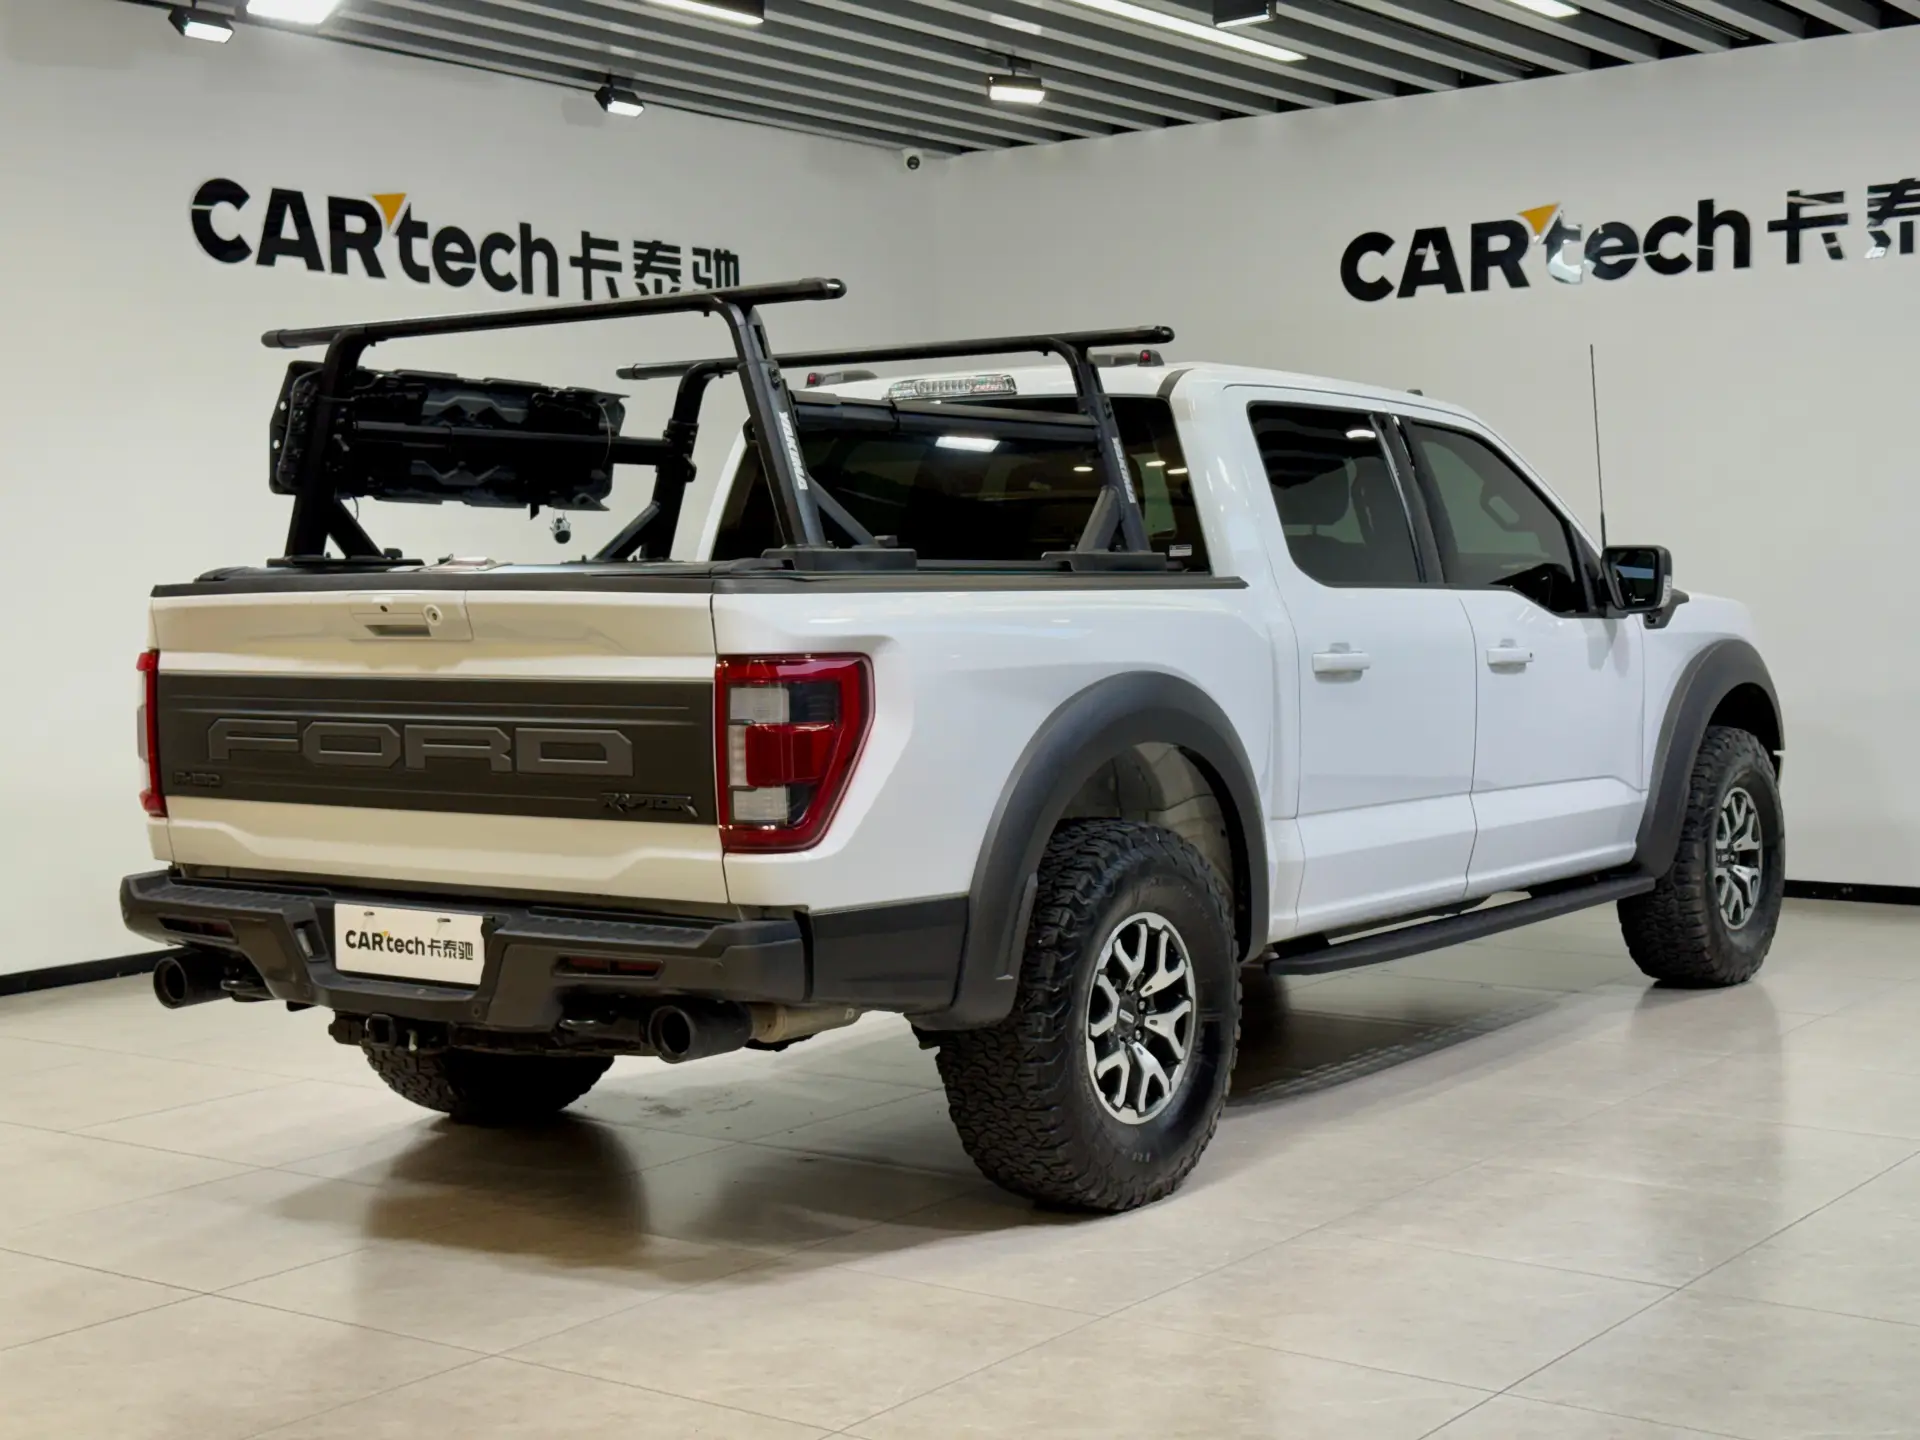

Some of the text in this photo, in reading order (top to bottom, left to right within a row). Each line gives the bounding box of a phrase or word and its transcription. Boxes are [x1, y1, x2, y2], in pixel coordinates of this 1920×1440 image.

[191, 177, 740, 300] CARtech 卡泰驰
[1340, 197, 1751, 302] CARtech
[778, 411, 809, 490] YAKIMA
[207, 717, 634, 777] FORD
[600, 791, 699, 818] RAPTOR
[345, 929, 473, 961] CARtech 卡泰驰
